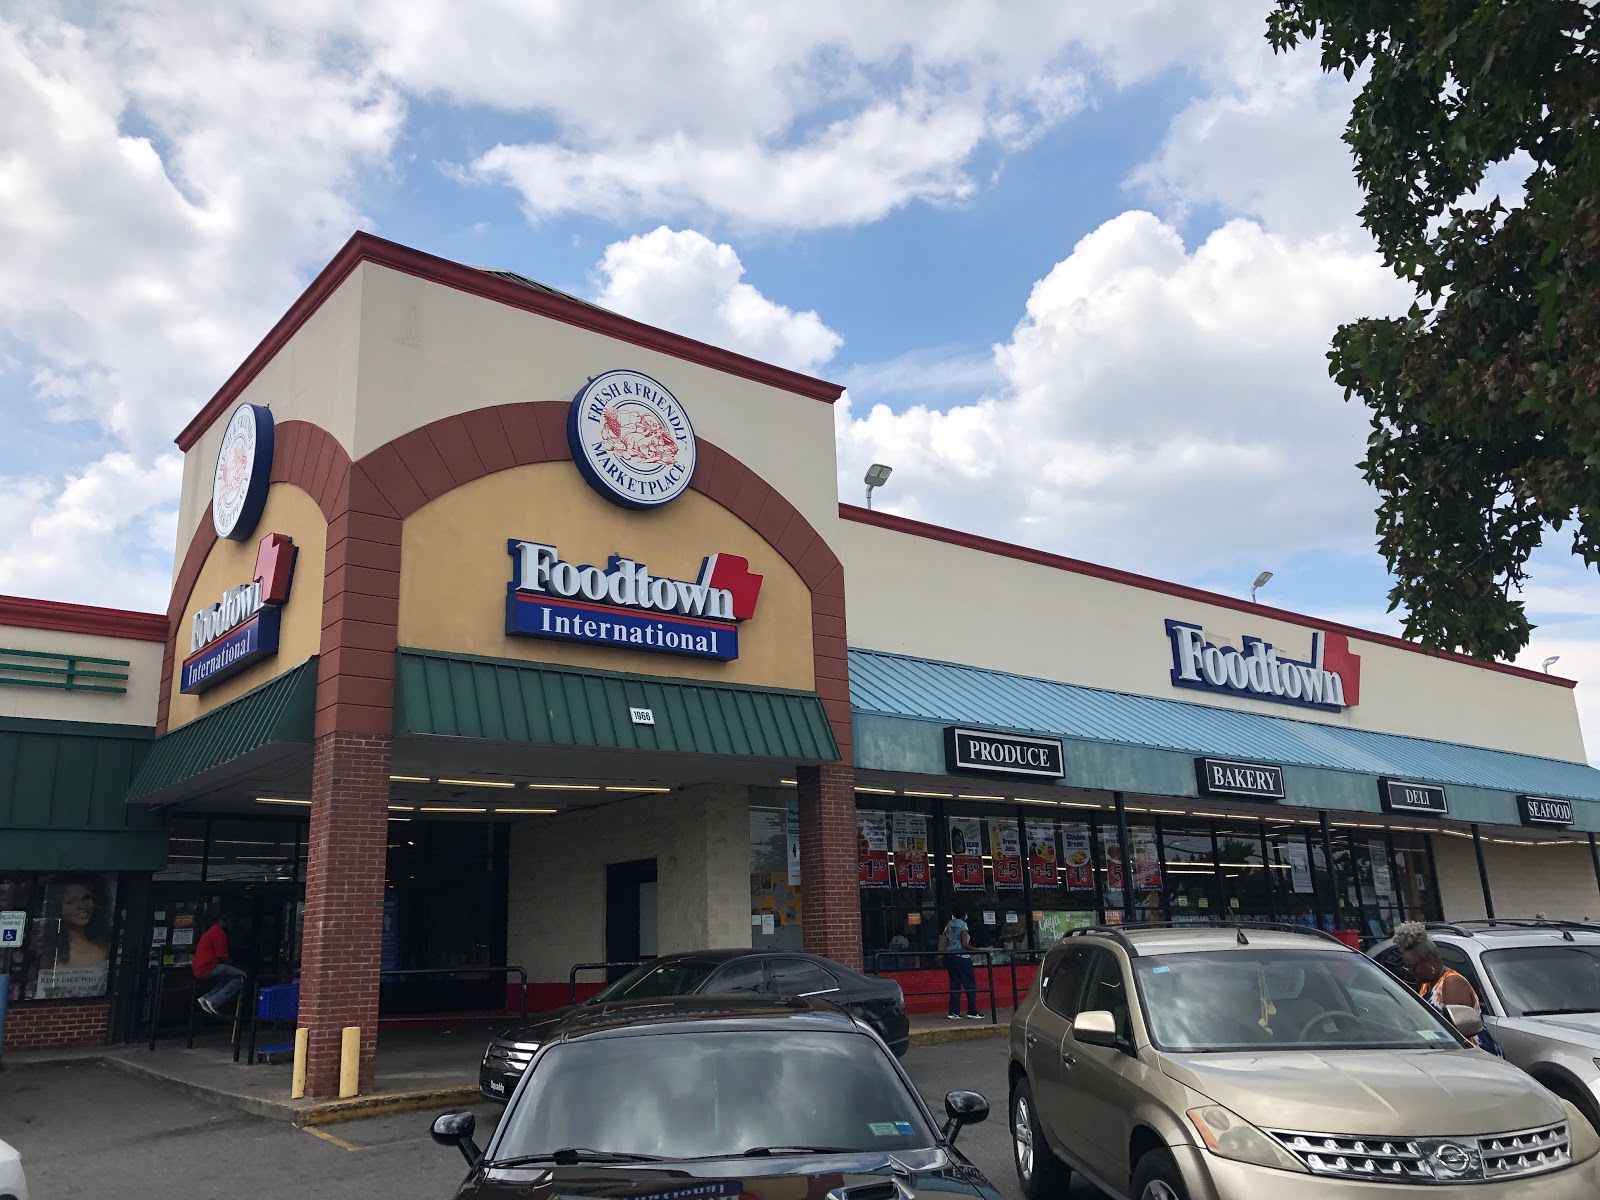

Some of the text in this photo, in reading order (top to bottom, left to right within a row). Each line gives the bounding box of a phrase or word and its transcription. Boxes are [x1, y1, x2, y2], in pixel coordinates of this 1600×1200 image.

[587, 380, 688, 445] FRESH & FRIENDLY
[591, 440, 687, 496] MARKETPLACE
[514, 541, 736, 620] Foodtown
[189, 578, 264, 655] Foodtown
[540, 606, 719, 654] International
[187, 628, 252, 687] International
[1172, 626, 1346, 706] Foodtown
[968, 739, 1051, 767] PRODUCE
[1212, 765, 1276, 791] BAKERY
[1405, 789, 1430, 806] DELI
[1527, 800, 1572, 820] SEAFOOD
